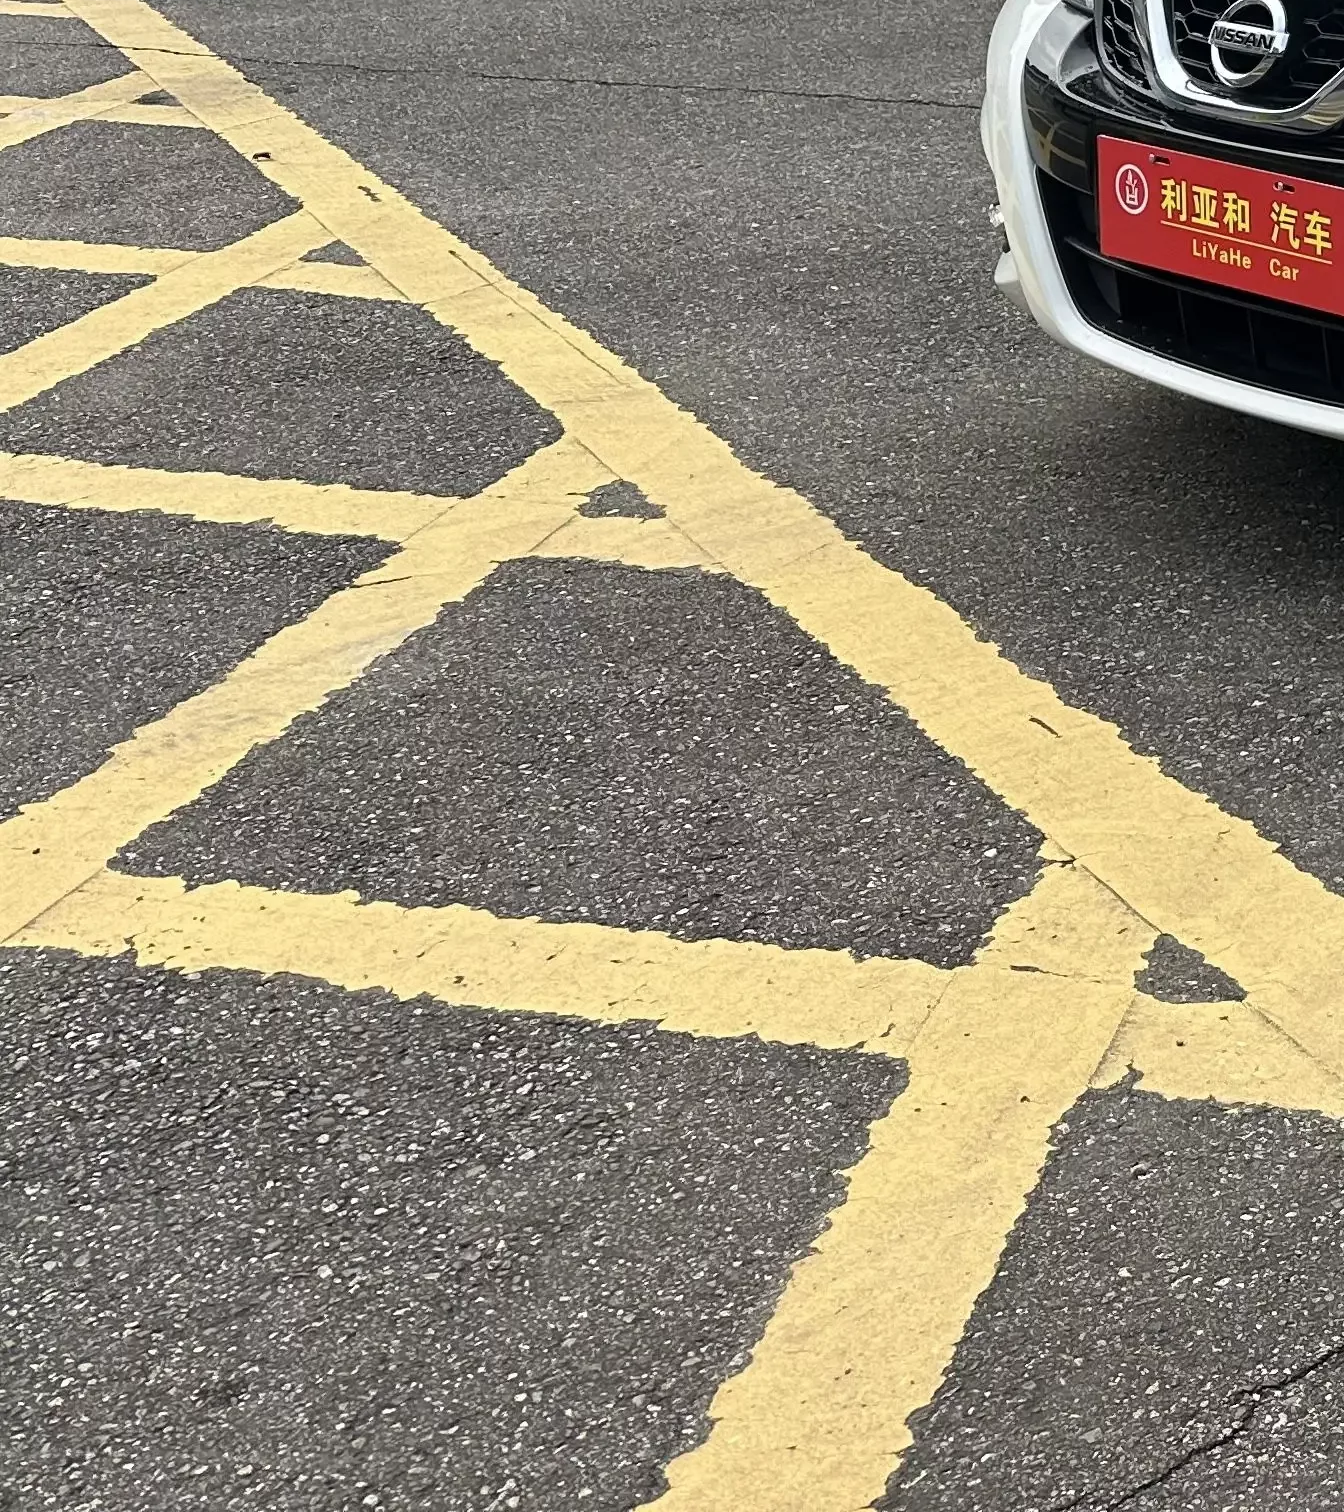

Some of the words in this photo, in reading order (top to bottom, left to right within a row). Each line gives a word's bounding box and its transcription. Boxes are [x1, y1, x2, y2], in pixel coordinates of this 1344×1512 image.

[1213, 25, 1275, 50] NISSAN
[1160, 178, 1251, 234] 利亚和
[1269, 201, 1334, 257] 汽车
[1191, 239, 1252, 269] LiYaHe
[1268, 258, 1300, 282] Car
